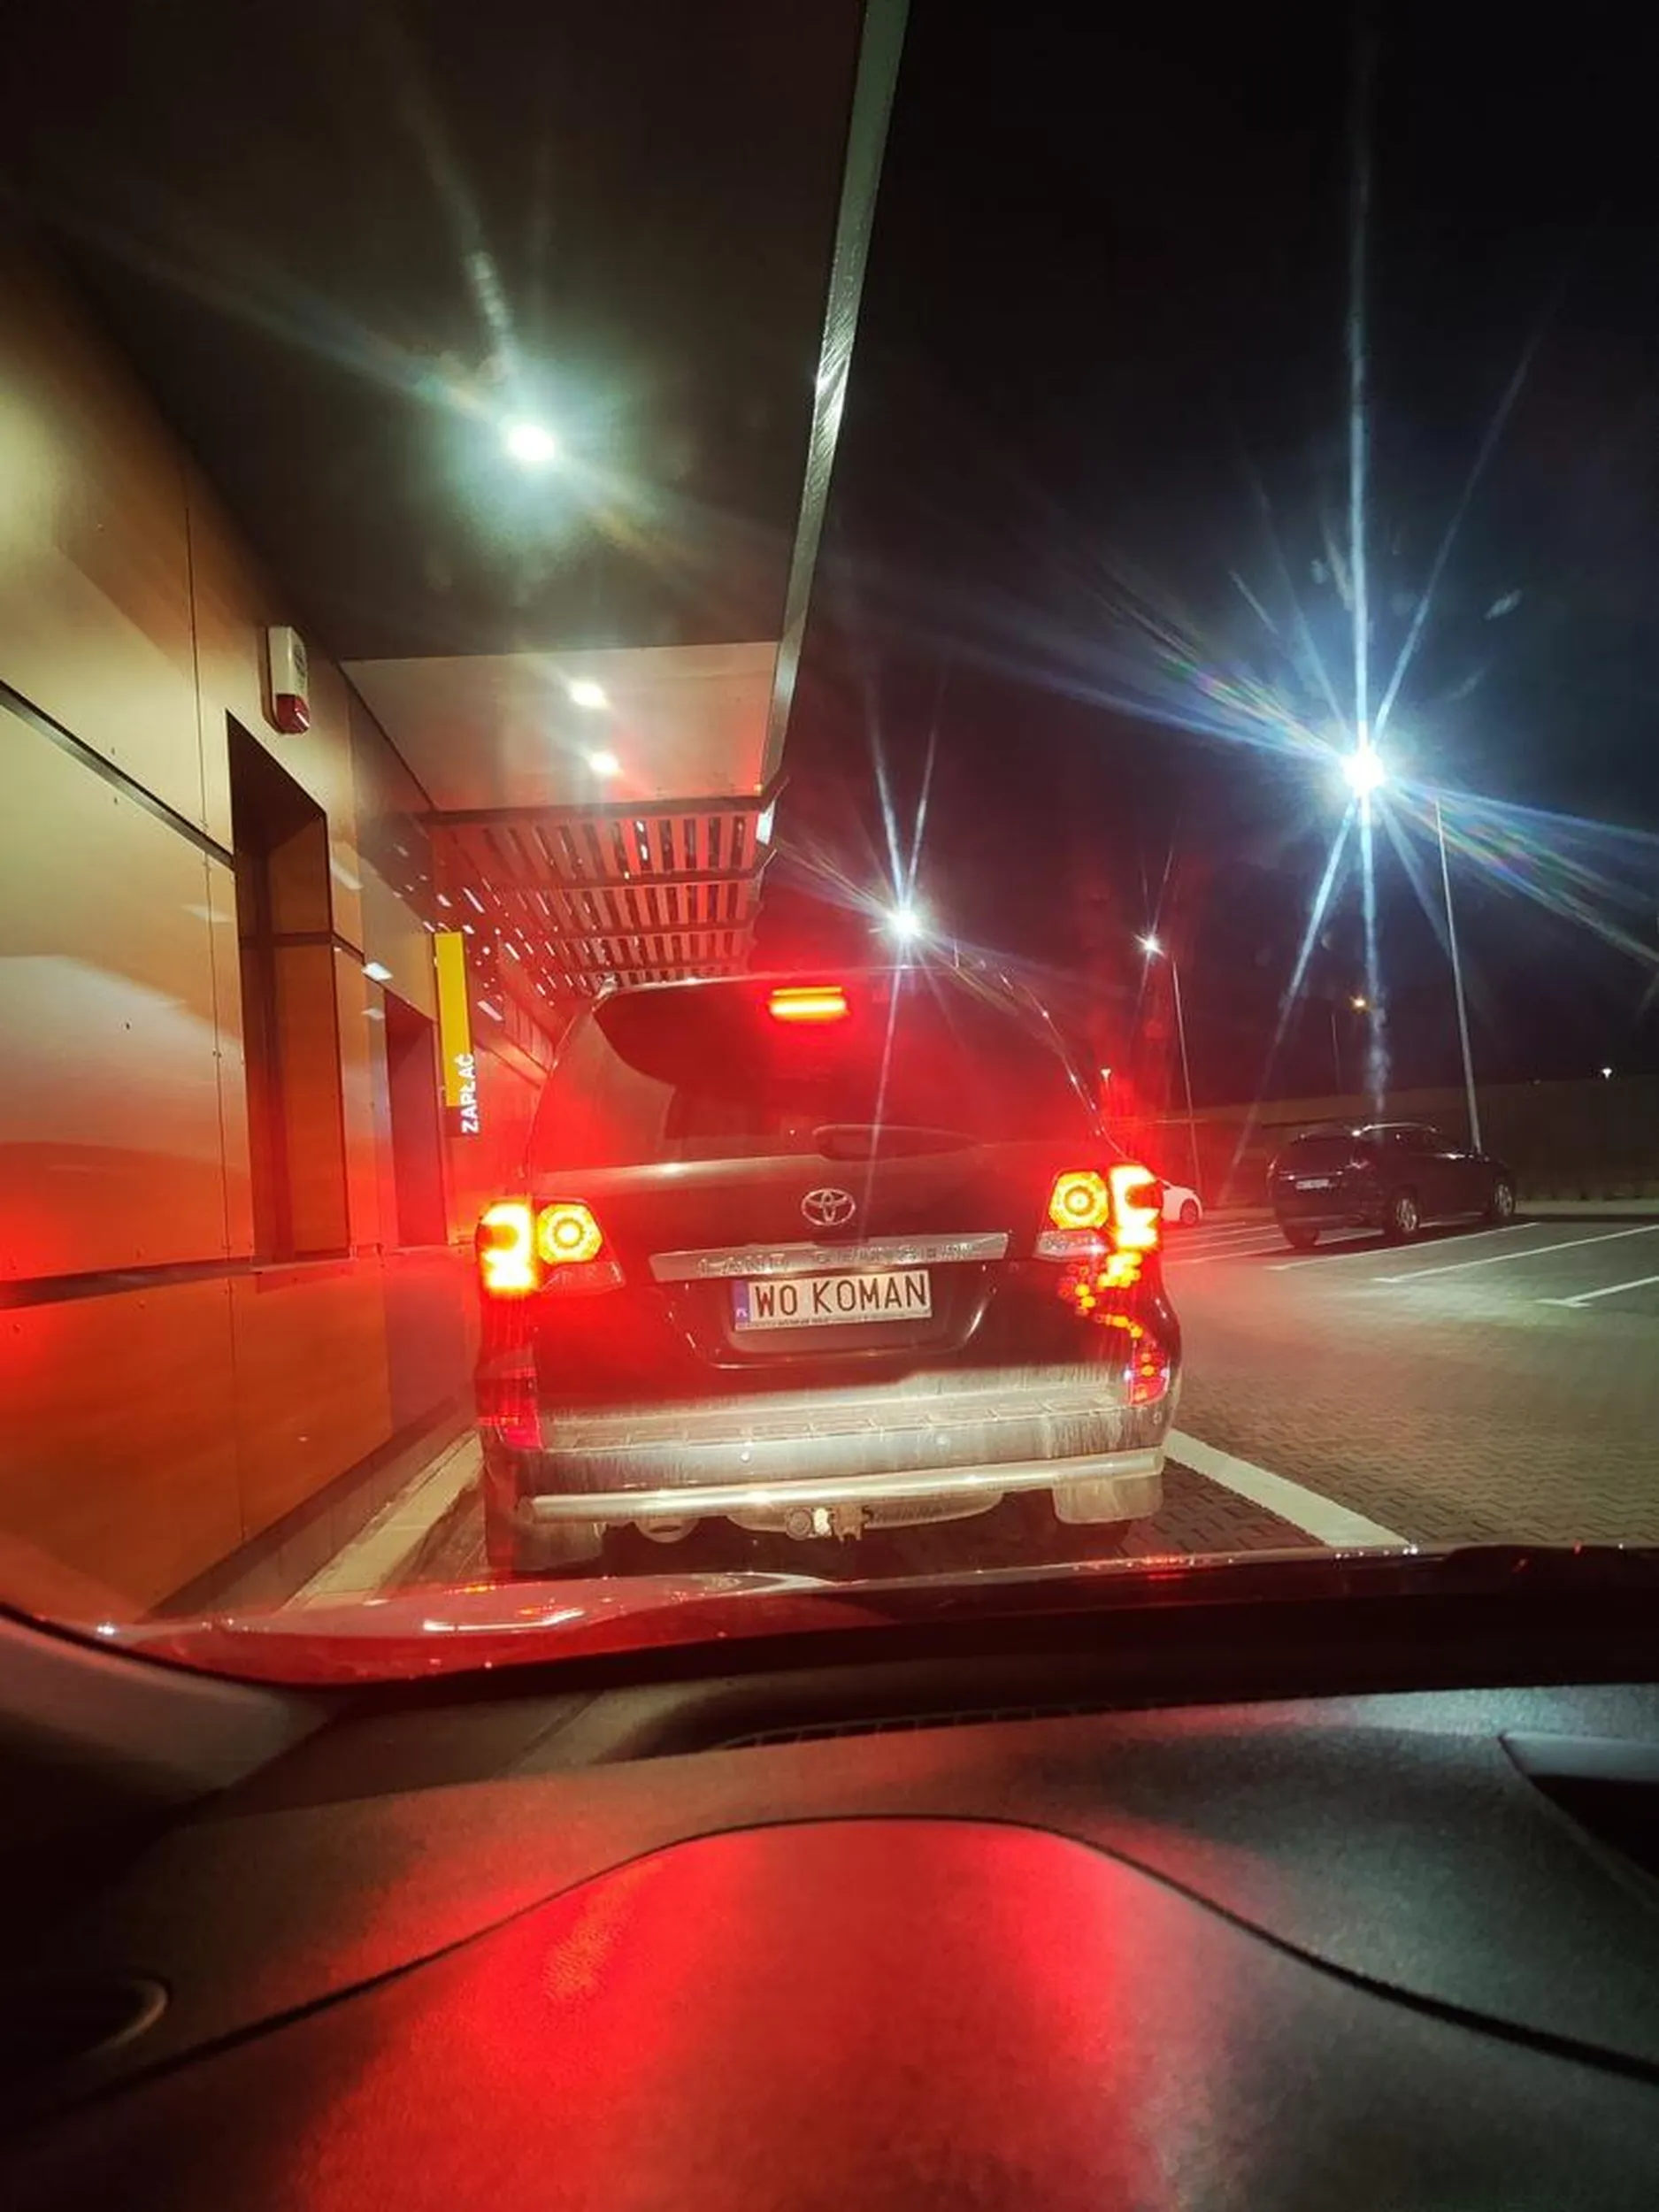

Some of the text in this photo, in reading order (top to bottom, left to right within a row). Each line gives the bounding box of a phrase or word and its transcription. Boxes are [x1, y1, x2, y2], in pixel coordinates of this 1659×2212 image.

[454, 1053, 480, 1133] ZAPŁAĆ
[755, 1274, 927, 1317] WO KOMAN
